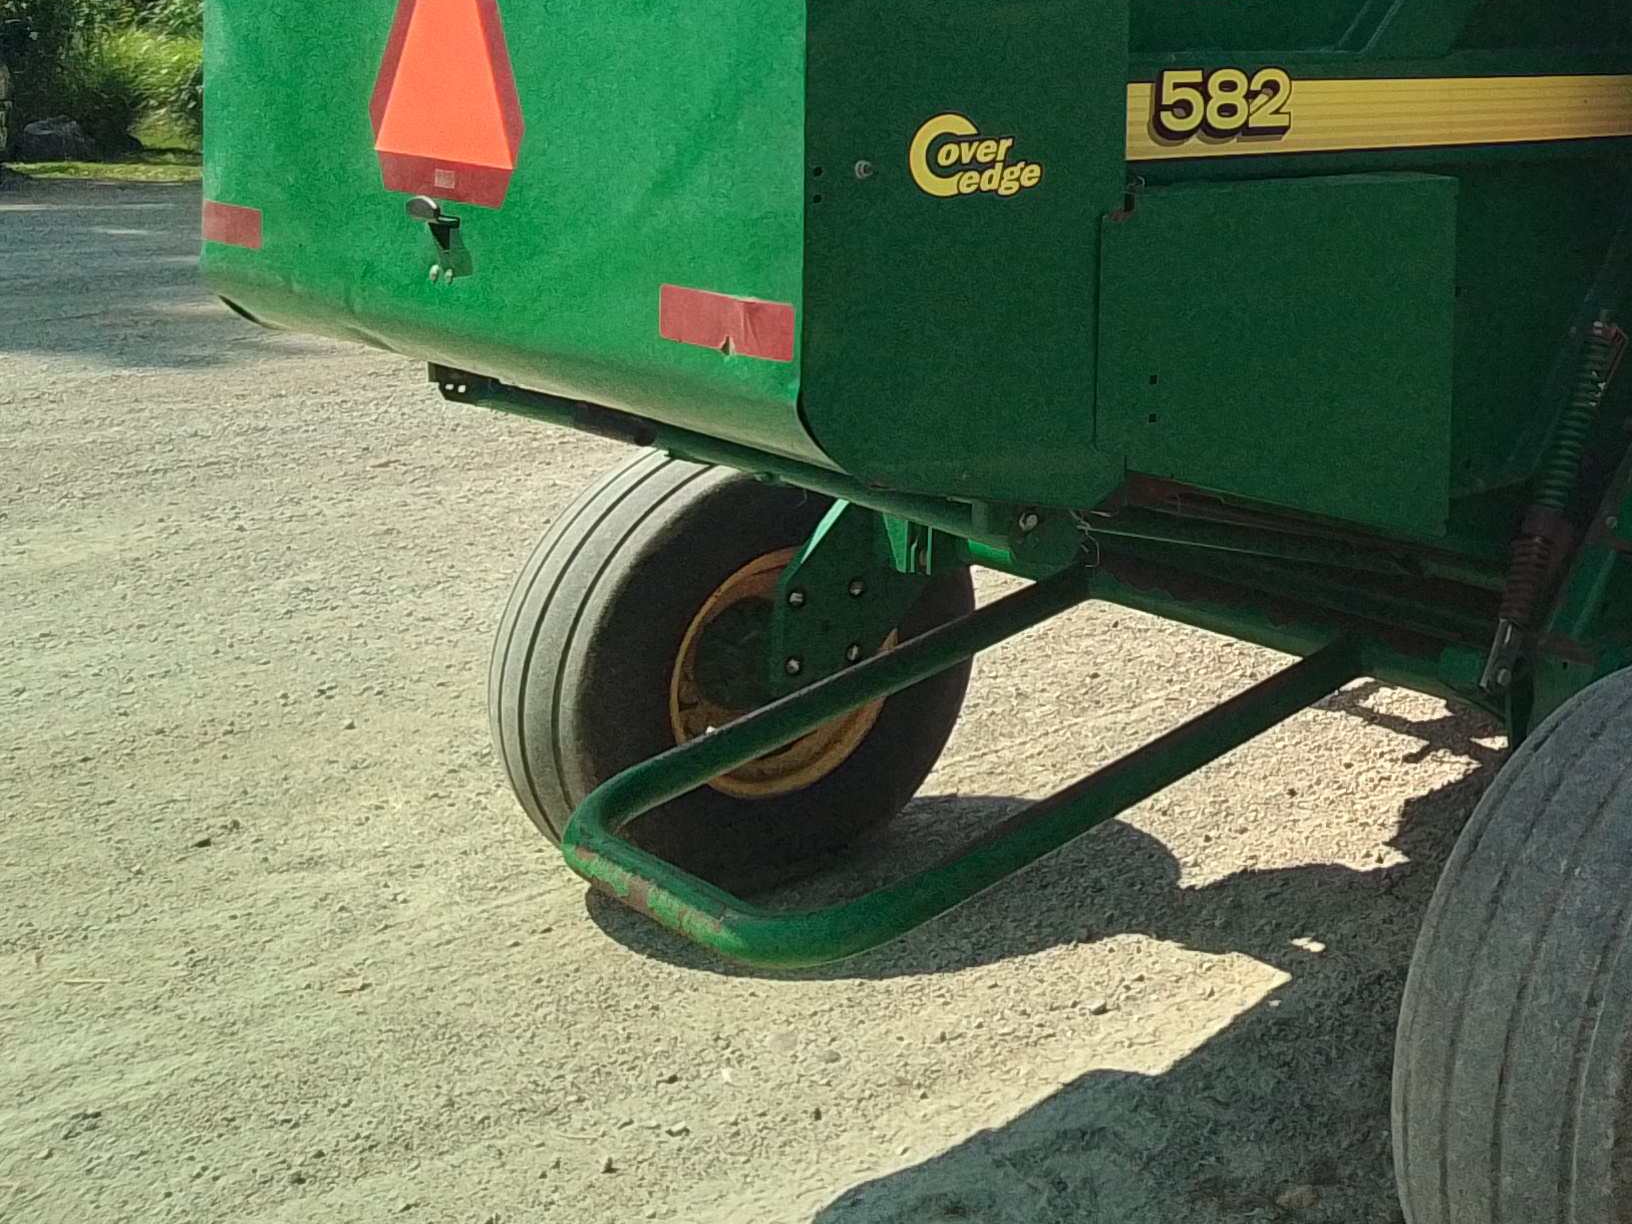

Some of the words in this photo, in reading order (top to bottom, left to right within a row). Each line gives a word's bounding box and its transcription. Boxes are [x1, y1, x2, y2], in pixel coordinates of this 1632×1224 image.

[1152, 69, 1291, 143] 582
[909, 112, 1014, 197] Cover
[956, 160, 1043, 196] edge
